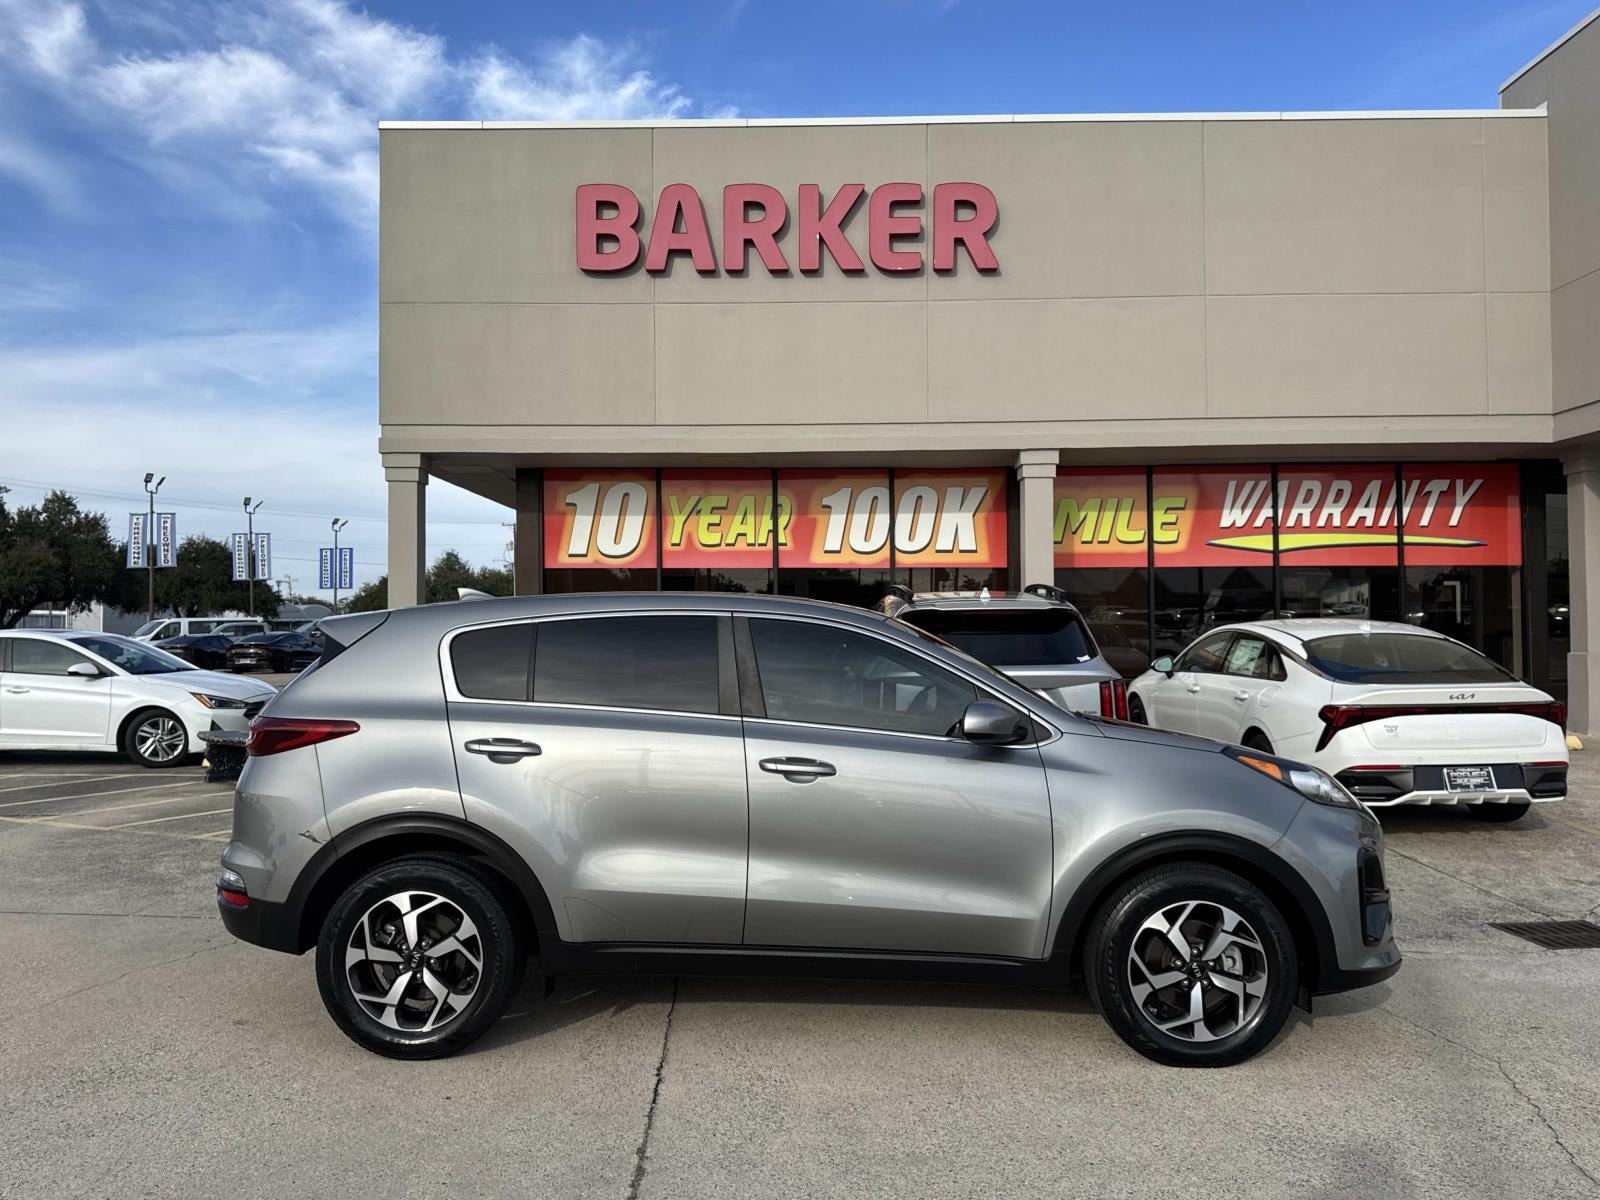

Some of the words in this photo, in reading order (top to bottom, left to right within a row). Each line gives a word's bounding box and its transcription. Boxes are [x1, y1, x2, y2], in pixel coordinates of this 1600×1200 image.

[576, 182, 1000, 274] BARKER
[132, 516, 142, 566] TERREBONNE
[162, 520, 170, 565] PREOWNED
[565, 481, 649, 558] 10
[668, 494, 793, 547] YEAR
[821, 485, 990, 555] 100K
[1053, 496, 1188, 544] MILE
[1218, 478, 1485, 529] WARRANTY
